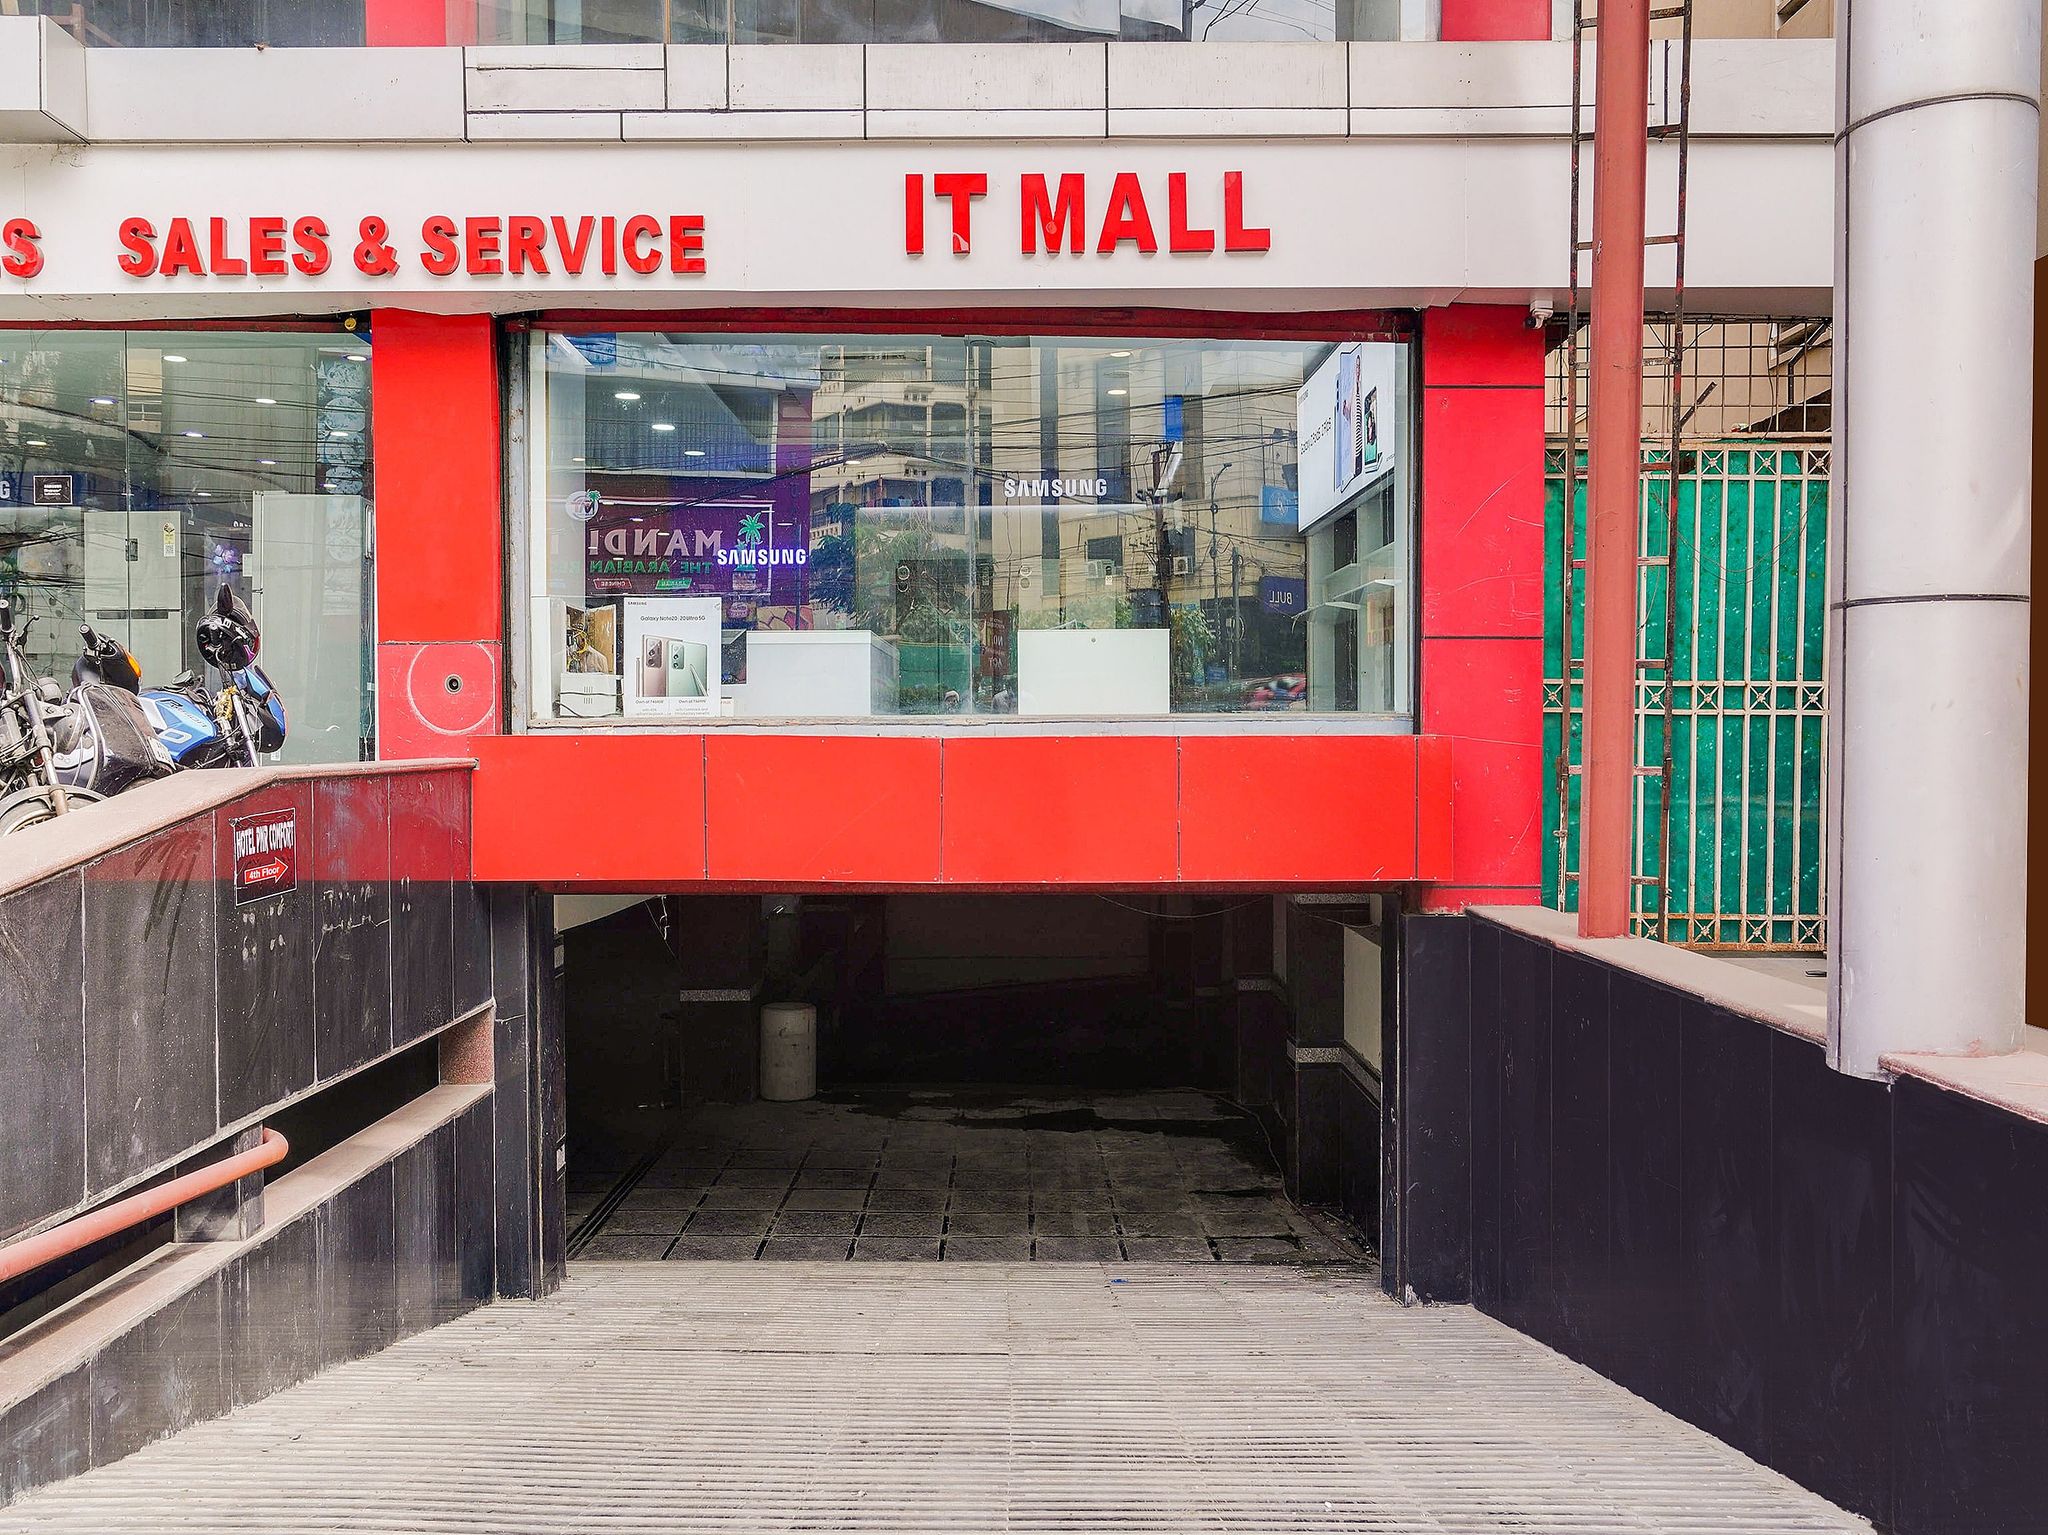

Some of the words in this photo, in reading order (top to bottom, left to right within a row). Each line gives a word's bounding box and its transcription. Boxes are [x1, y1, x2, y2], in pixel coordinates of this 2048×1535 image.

[904, 172, 988, 255] IT
[1020, 170, 1271, 255] MALL
[0, 217, 45, 278] S
[118, 214, 331, 277] SALES
[352, 215, 400, 277] &
[420, 213, 707, 276] SERVICE
[1004, 478, 1108, 498] SAMSUNG
[716, 549, 807, 566] SAMSUNG
[236, 828, 256, 860] HOTEL
[249, 870, 260, 879] 4th
[262, 866, 280, 877] Floor
